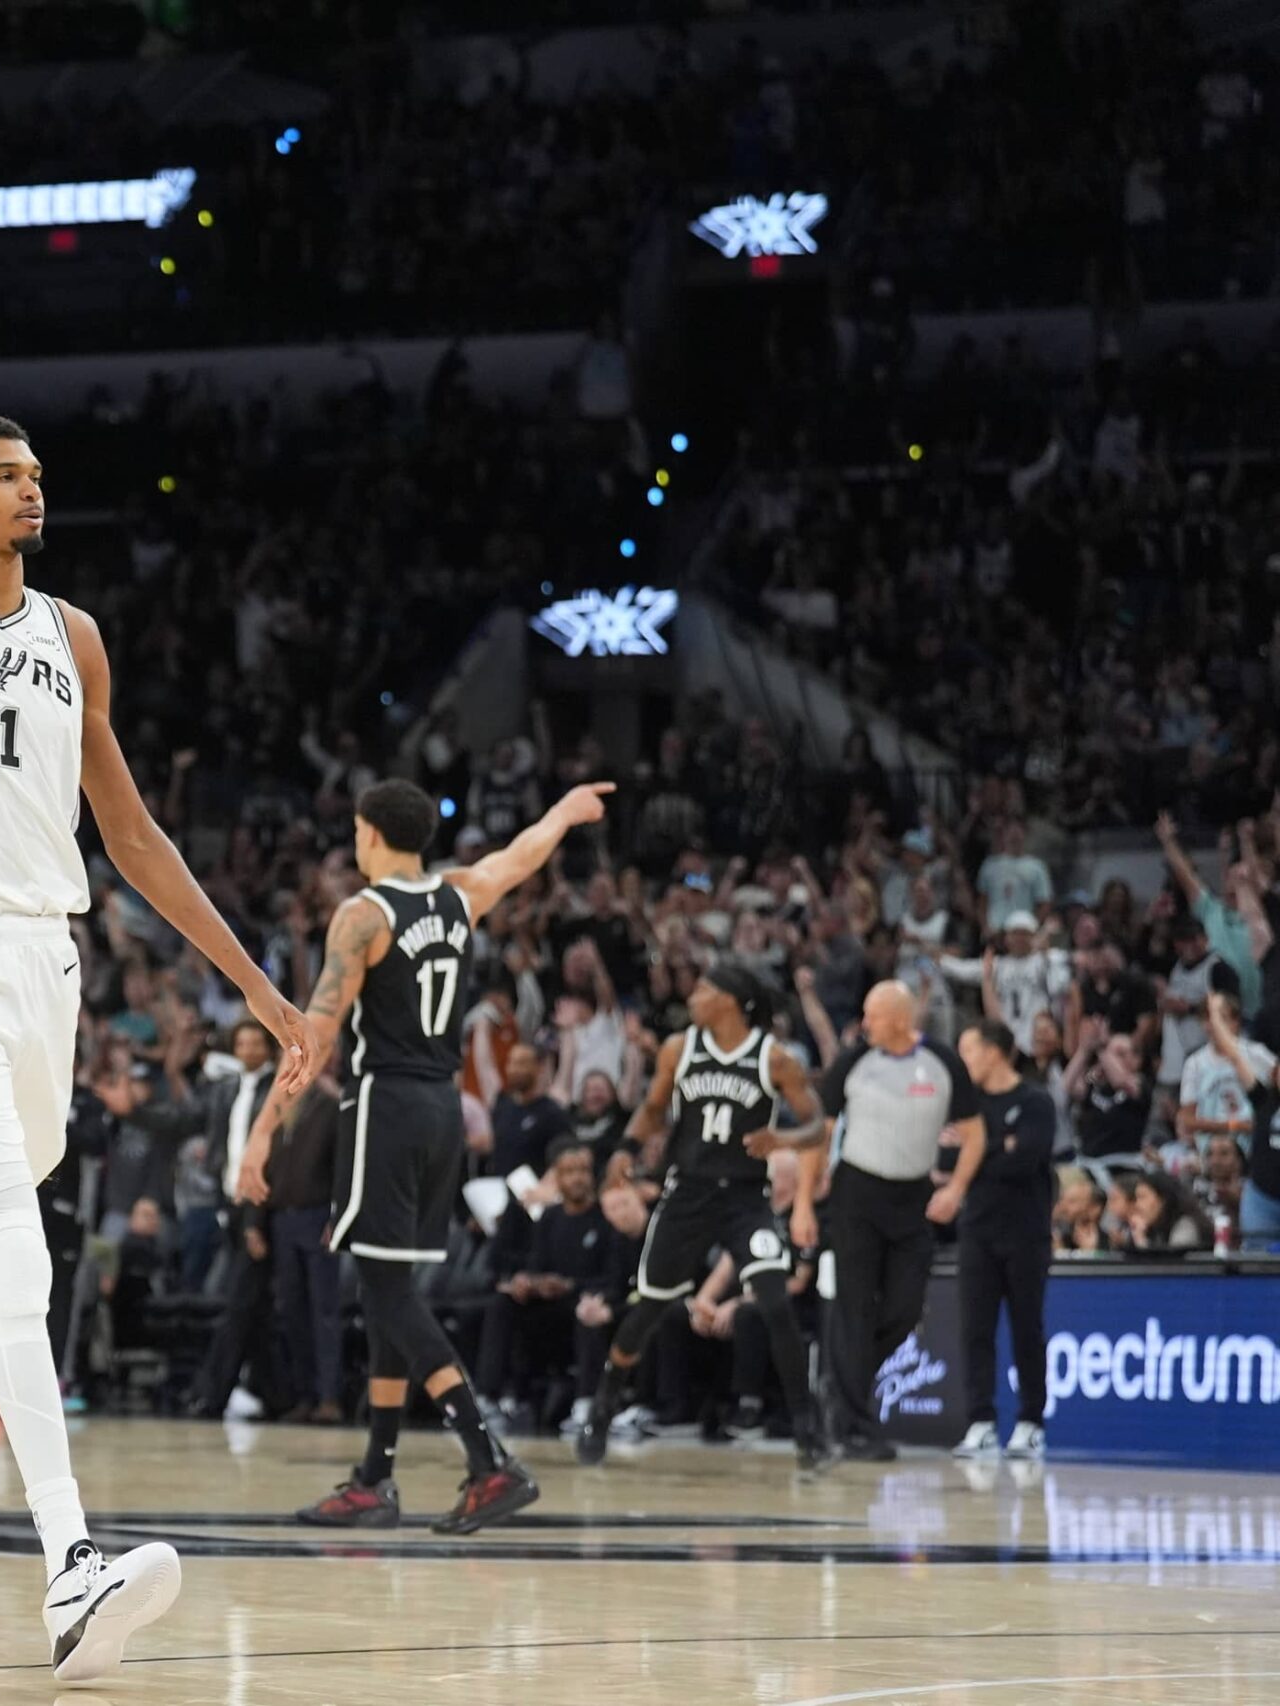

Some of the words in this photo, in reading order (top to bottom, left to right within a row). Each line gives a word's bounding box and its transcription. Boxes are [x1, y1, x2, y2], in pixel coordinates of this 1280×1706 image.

[416, 957, 458, 1038] 17
[701, 1102, 733, 1144] 14
[1008, 1317, 1276, 1418] pectrum
